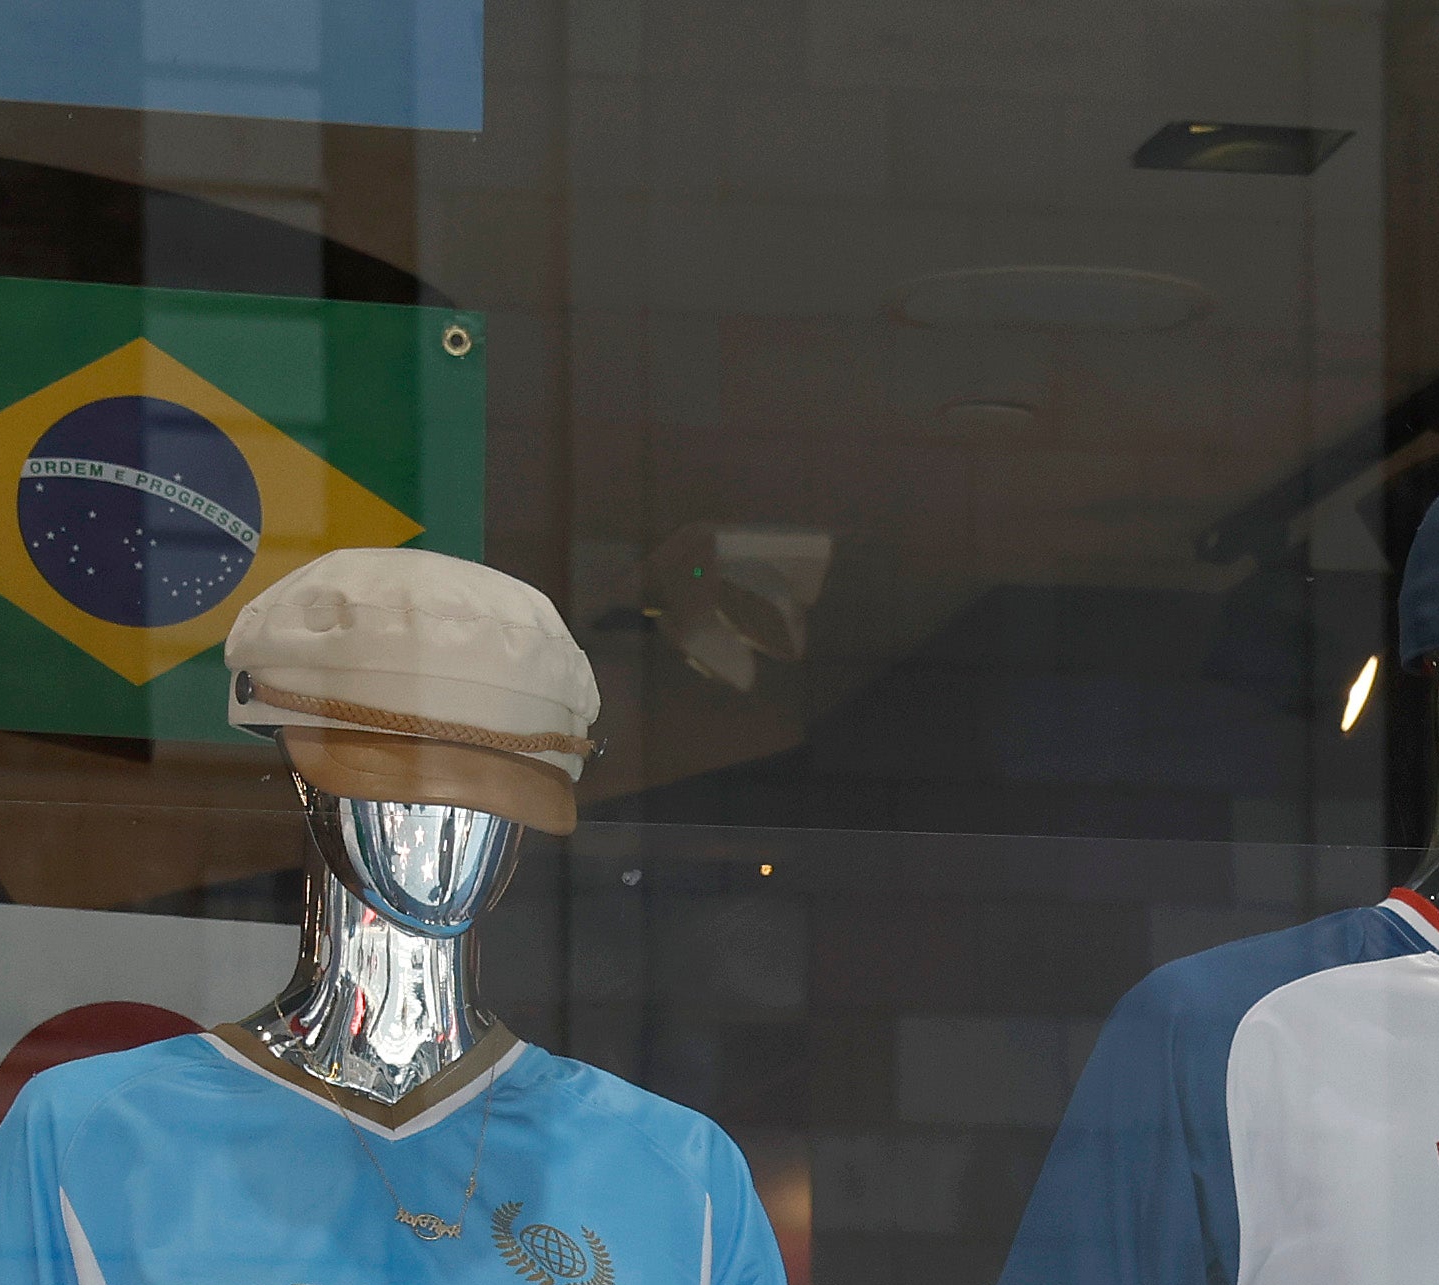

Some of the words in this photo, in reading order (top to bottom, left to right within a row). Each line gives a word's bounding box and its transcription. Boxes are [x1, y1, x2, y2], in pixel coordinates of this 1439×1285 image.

[30, 460, 104, 477] ORDEM
[114, 469, 125, 481] E
[135, 473, 254, 544] PROGRESSO
